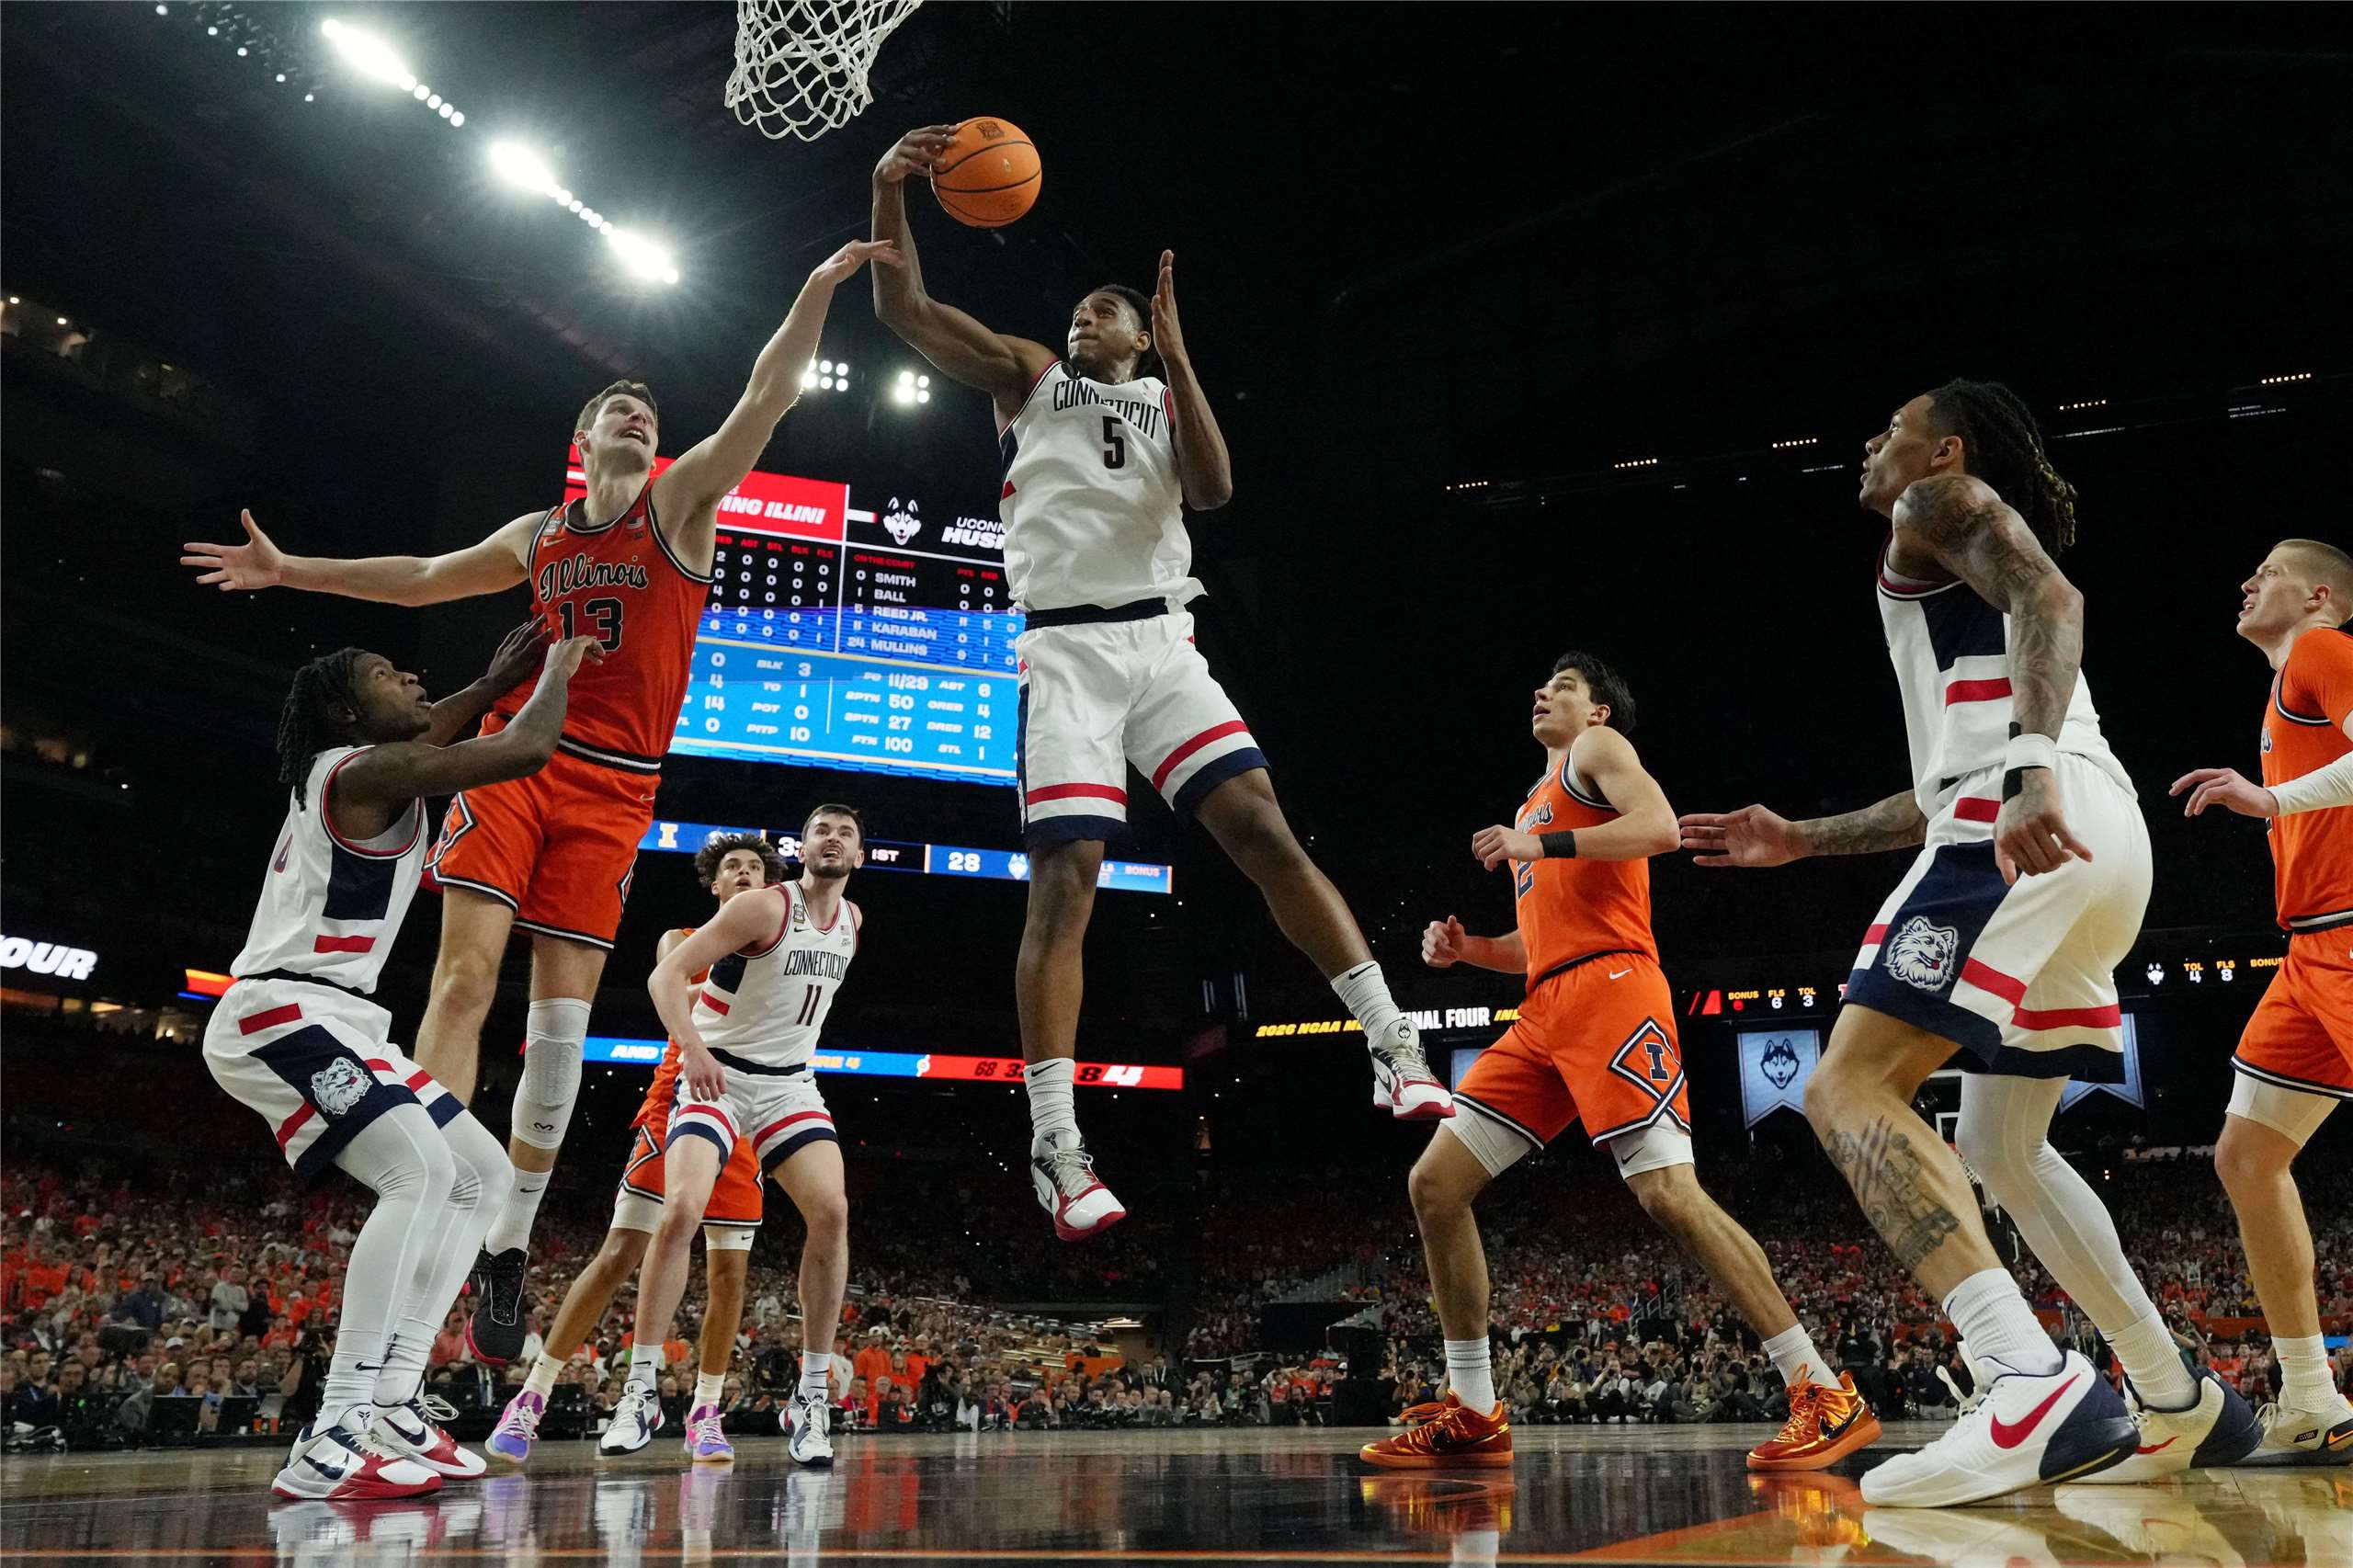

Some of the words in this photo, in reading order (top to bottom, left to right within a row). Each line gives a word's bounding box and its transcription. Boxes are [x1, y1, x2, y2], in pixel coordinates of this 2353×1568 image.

[1102, 415, 1125, 469] 5
[764, 501, 826, 525] ILLINI
[716, 551, 726, 562] 2
[742, 554, 753, 565] 0
[767, 558, 779, 569] 0
[793, 561, 804, 572] 0
[818, 564, 829, 575] 0
[539, 552, 648, 603] Illinois
[714, 567, 725, 579] 0
[740, 571, 751, 583] 0
[766, 574, 777, 585] 0
[791, 578, 802, 589] 0
[817, 581, 827, 593] 0
[856, 570, 867, 581] 0
[875, 572, 916, 587] SMITH
[960, 584, 971, 595] 0
[983, 586, 994, 597] 0
[712, 585, 723, 597] 4
[739, 588, 750, 599] 0
[765, 592, 776, 603] 0
[790, 596, 801, 607] 0
[819, 598, 824, 608] 1
[857, 586, 862, 597] 1
[874, 588, 906, 602] BALL
[959, 600, 970, 611] 0
[983, 603, 993, 614] 0
[1007, 607, 1017, 617] 0
[559, 597, 623, 653] 13
[711, 602, 722, 613] 0
[738, 606, 748, 617] 0
[764, 609, 774, 620] 0
[790, 612, 800, 623] 0
[817, 616, 823, 626] 1
[873, 606, 908, 619] REED
[910, 610, 928, 622] JR.
[1006, 622, 1017, 633] 0
[736, 623, 747, 634] 0
[762, 626, 773, 637] 0
[788, 630, 799, 641] 0
[816, 633, 821, 643] 1
[872, 621, 938, 641] KARABAN
[958, 632, 968, 643] 0
[983, 636, 989, 647] 1
[710, 652, 725, 667] 0
[798, 663, 812, 676] 3
[870, 639, 927, 656] MULLINS
[983, 653, 988, 663] 1
[1005, 654, 1015, 666] 0
[710, 674, 723, 689] 4
[763, 681, 781, 691] TO
[800, 684, 806, 698] 1
[705, 695, 725, 710] 14
[794, 705, 809, 721] 0
[889, 694, 915, 710] 50
[977, 704, 990, 719] 4
[705, 717, 721, 733] 0
[790, 727, 810, 742] 10
[888, 715, 912, 732] 27
[973, 725, 992, 740] 12
[884, 736, 913, 753] 100
[978, 745, 985, 761] 1
[948, 852, 981, 872] 28
[1124, 865, 1160, 878] BONUS
[0, 935, 98, 981] OUR
[784, 949, 849, 982] CONNECTICUT
[2184, 963, 2203, 971] TOL
[2216, 960, 2235, 970] FLS
[2189, 971, 2201, 983] 4
[2221, 969, 2234, 982] 8
[1728, 990, 1759, 1000] BONUS
[1768, 989, 1785, 997] FLS
[1771, 997, 1783, 1009] 6
[1798, 987, 1816, 995] TOL
[1802, 995, 1814, 1007] 3
[796, 983, 823, 1027] 11
[1256, 1024, 1296, 1037] 2026
[1297, 1019, 1340, 1035] NCAA
[1445, 1006, 1490, 1029] FOUR
[609, 1044, 659, 1060] AND
[845, 1056, 861, 1070] 4
[1643, 1042, 1670, 1081] I
[974, 1061, 997, 1076] 68
[1078, 1066, 1102, 1082] 8
